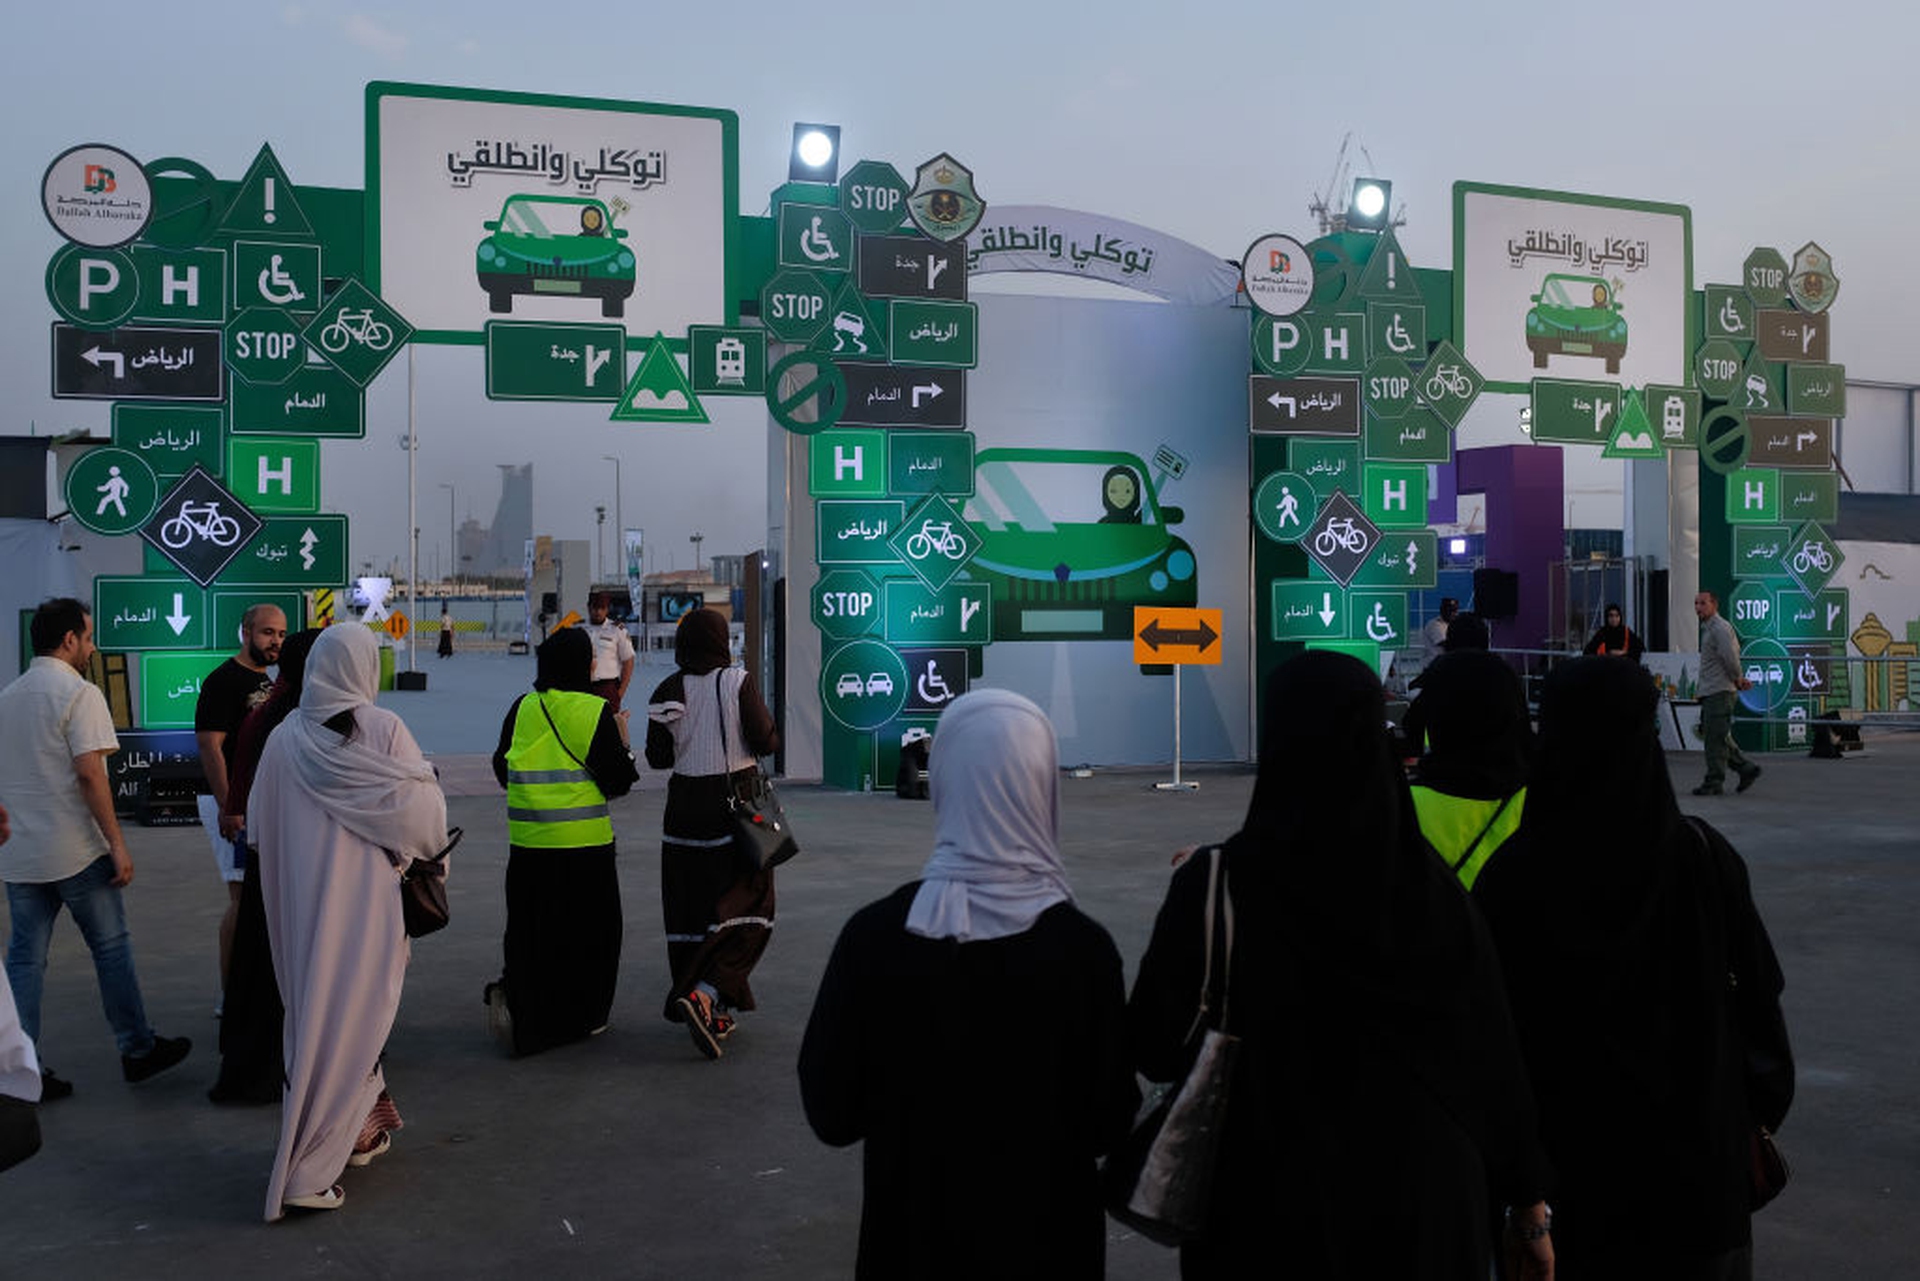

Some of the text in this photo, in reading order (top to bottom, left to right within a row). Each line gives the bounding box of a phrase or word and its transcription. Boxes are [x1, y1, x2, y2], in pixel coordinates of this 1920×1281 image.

[447, 140, 663, 190] توكلي وانطلقي
[851, 184, 900, 211] STOP
[1071, 234, 1153, 273] توكلي
[1508, 230, 1646, 272] توكلي وانطلقي
[79, 259, 120, 310] P
[162, 265, 199, 306] H
[1751, 268, 1784, 288] STOP
[772, 293, 823, 320] STOP
[909, 322, 958, 341] الرياض
[1272, 322, 1299, 363] P
[236, 331, 297, 359] STOP
[551, 344, 580, 363] جدة
[1324, 327, 1349, 360] H
[131, 348, 194, 370] الرياض
[1703, 358, 1737, 380] STOP
[867, 388, 901, 405] الدمام
[1371, 378, 1409, 400] STOP
[285, 393, 326, 414] الدمام
[1300, 393, 1342, 411] الرياض
[139, 430, 200, 450] الرياض
[834, 446, 863, 480] H
[1306, 460, 1345, 476] الرياض
[258, 456, 292, 495] H
[1383, 479, 1407, 511] H
[1744, 481, 1764, 510] H
[837, 520, 888, 540] الرياض
[255, 545, 288, 559] تبوك
[822, 592, 873, 617] STOP
[910, 605, 944, 623] الدمام
[1735, 600, 1770, 620] STOP
[113, 607, 157, 628] الدمام
